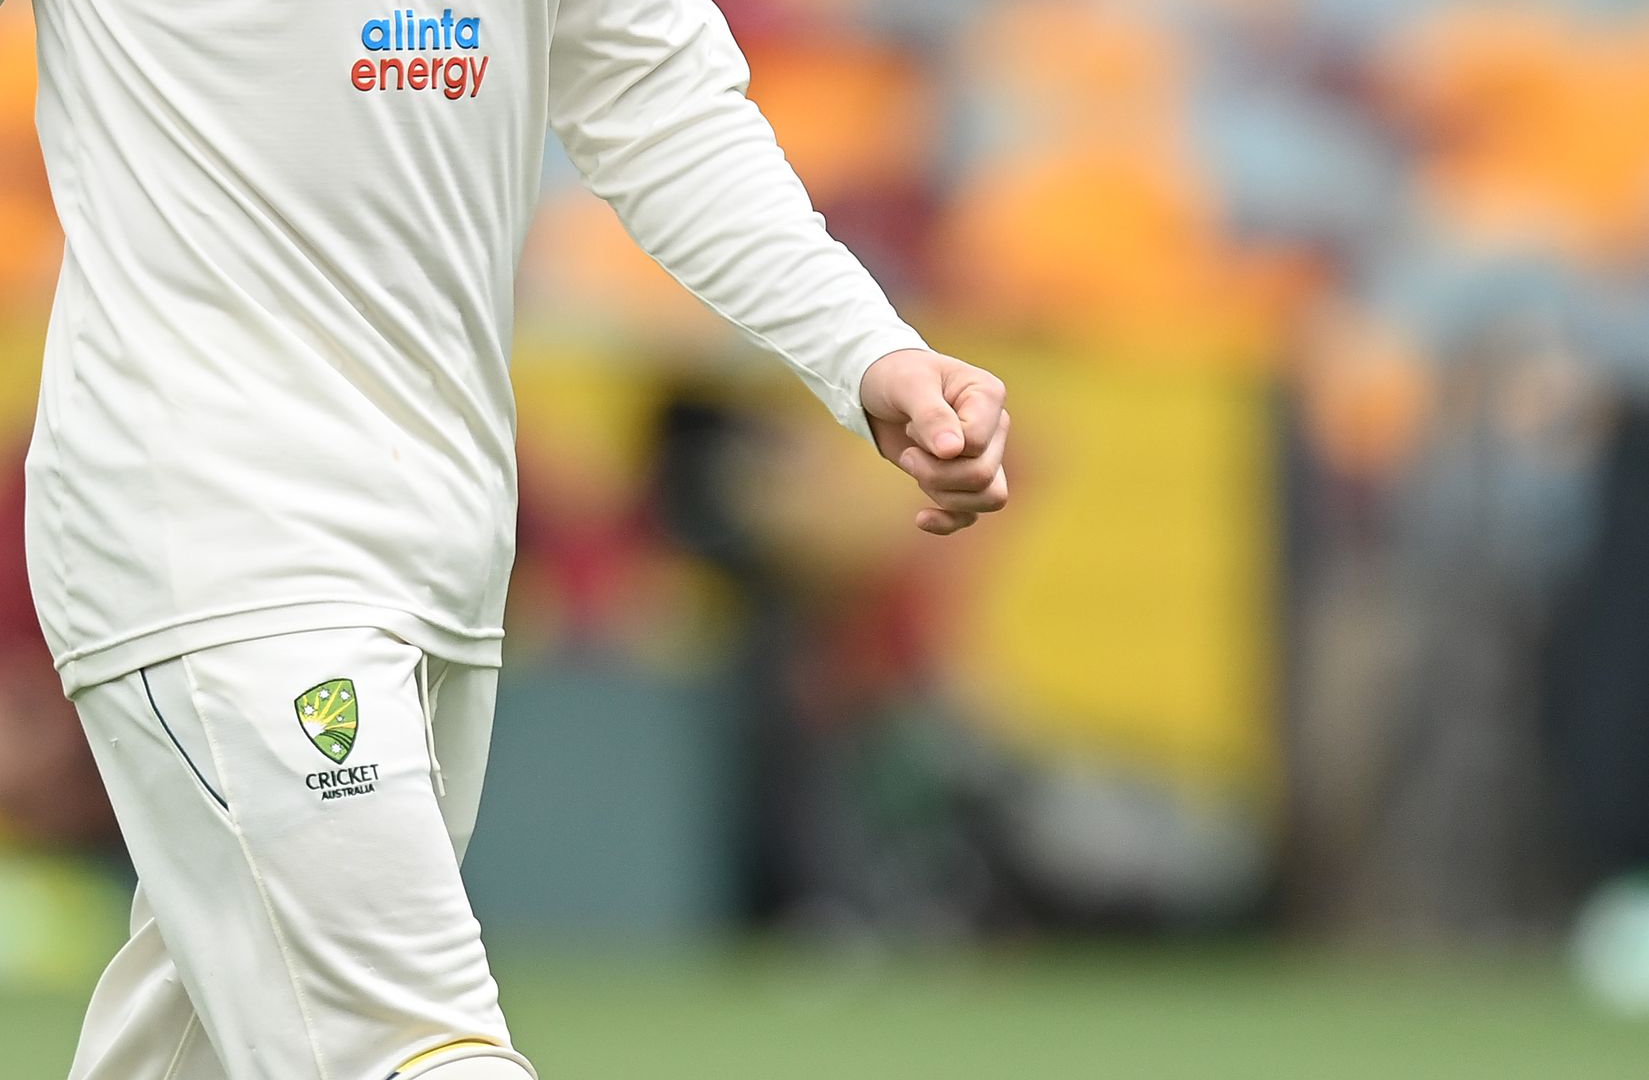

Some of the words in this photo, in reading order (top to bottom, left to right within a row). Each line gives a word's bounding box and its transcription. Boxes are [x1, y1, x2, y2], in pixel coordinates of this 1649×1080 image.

[361, 8, 481, 51] alinta
[351, 54, 490, 100] energy
[305, 764, 380, 790] CRICKET
[321, 783, 375, 800] AUSTRALIA
